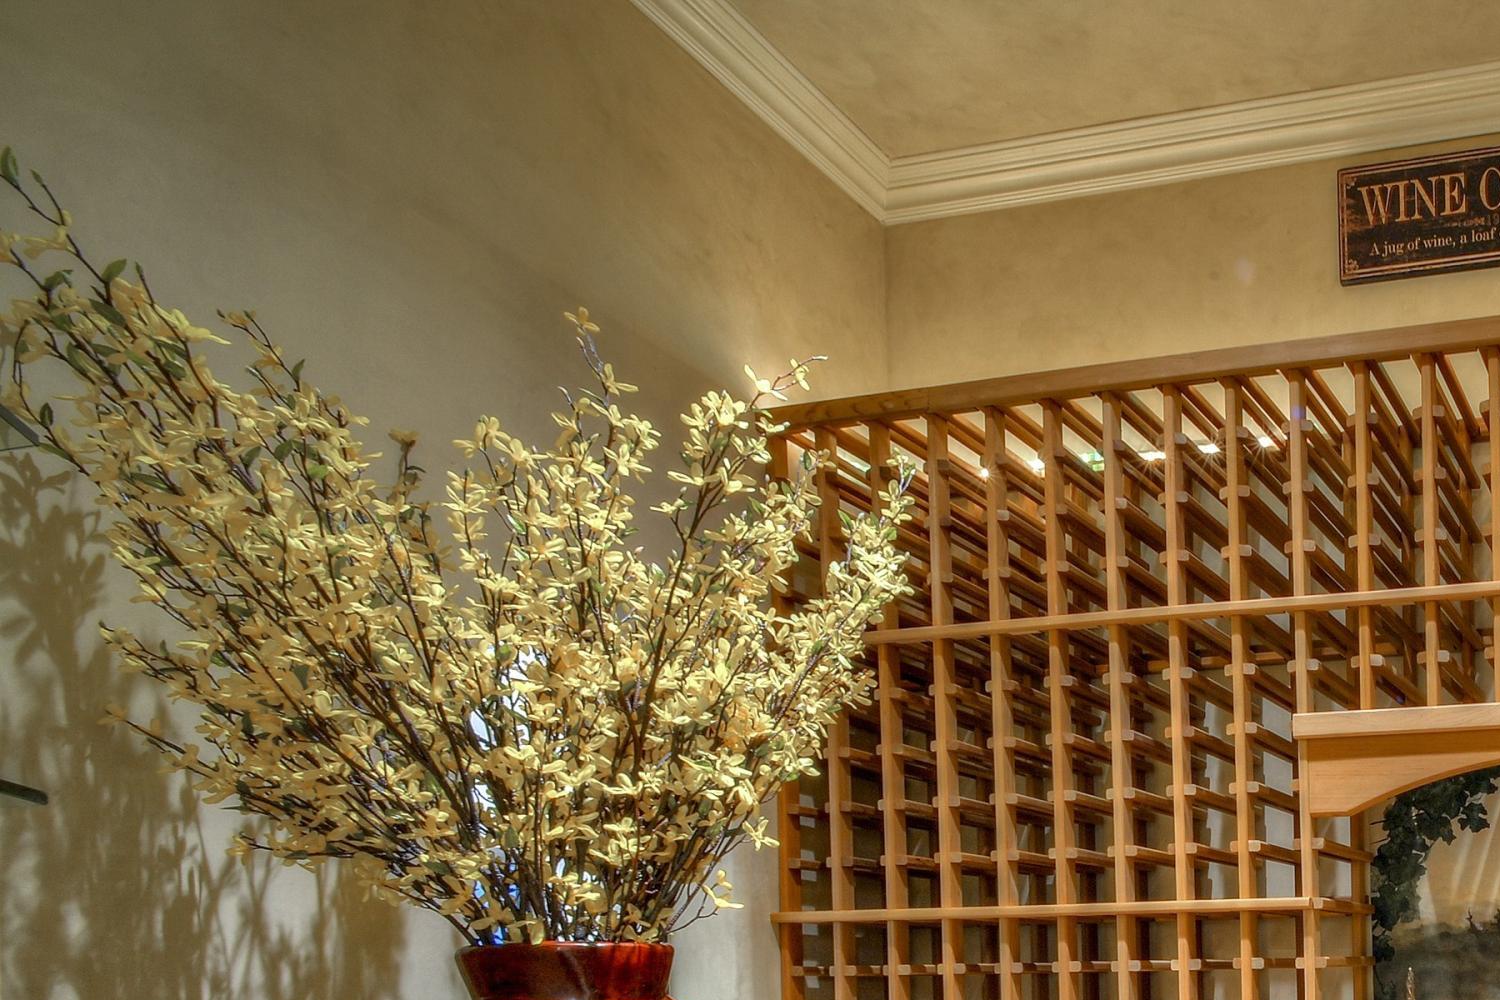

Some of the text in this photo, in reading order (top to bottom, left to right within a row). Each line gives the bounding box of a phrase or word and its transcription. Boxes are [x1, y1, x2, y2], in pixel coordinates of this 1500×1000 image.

[1357, 173, 1466, 226] WINE
[1369, 242, 1380, 256] A
[1382, 241, 1405, 257] jug
[1407, 237, 1421, 251] of
[1423, 235, 1456, 249] wine,
[1460, 234, 1467, 245] a
[1472, 227, 1497, 242] loaf
